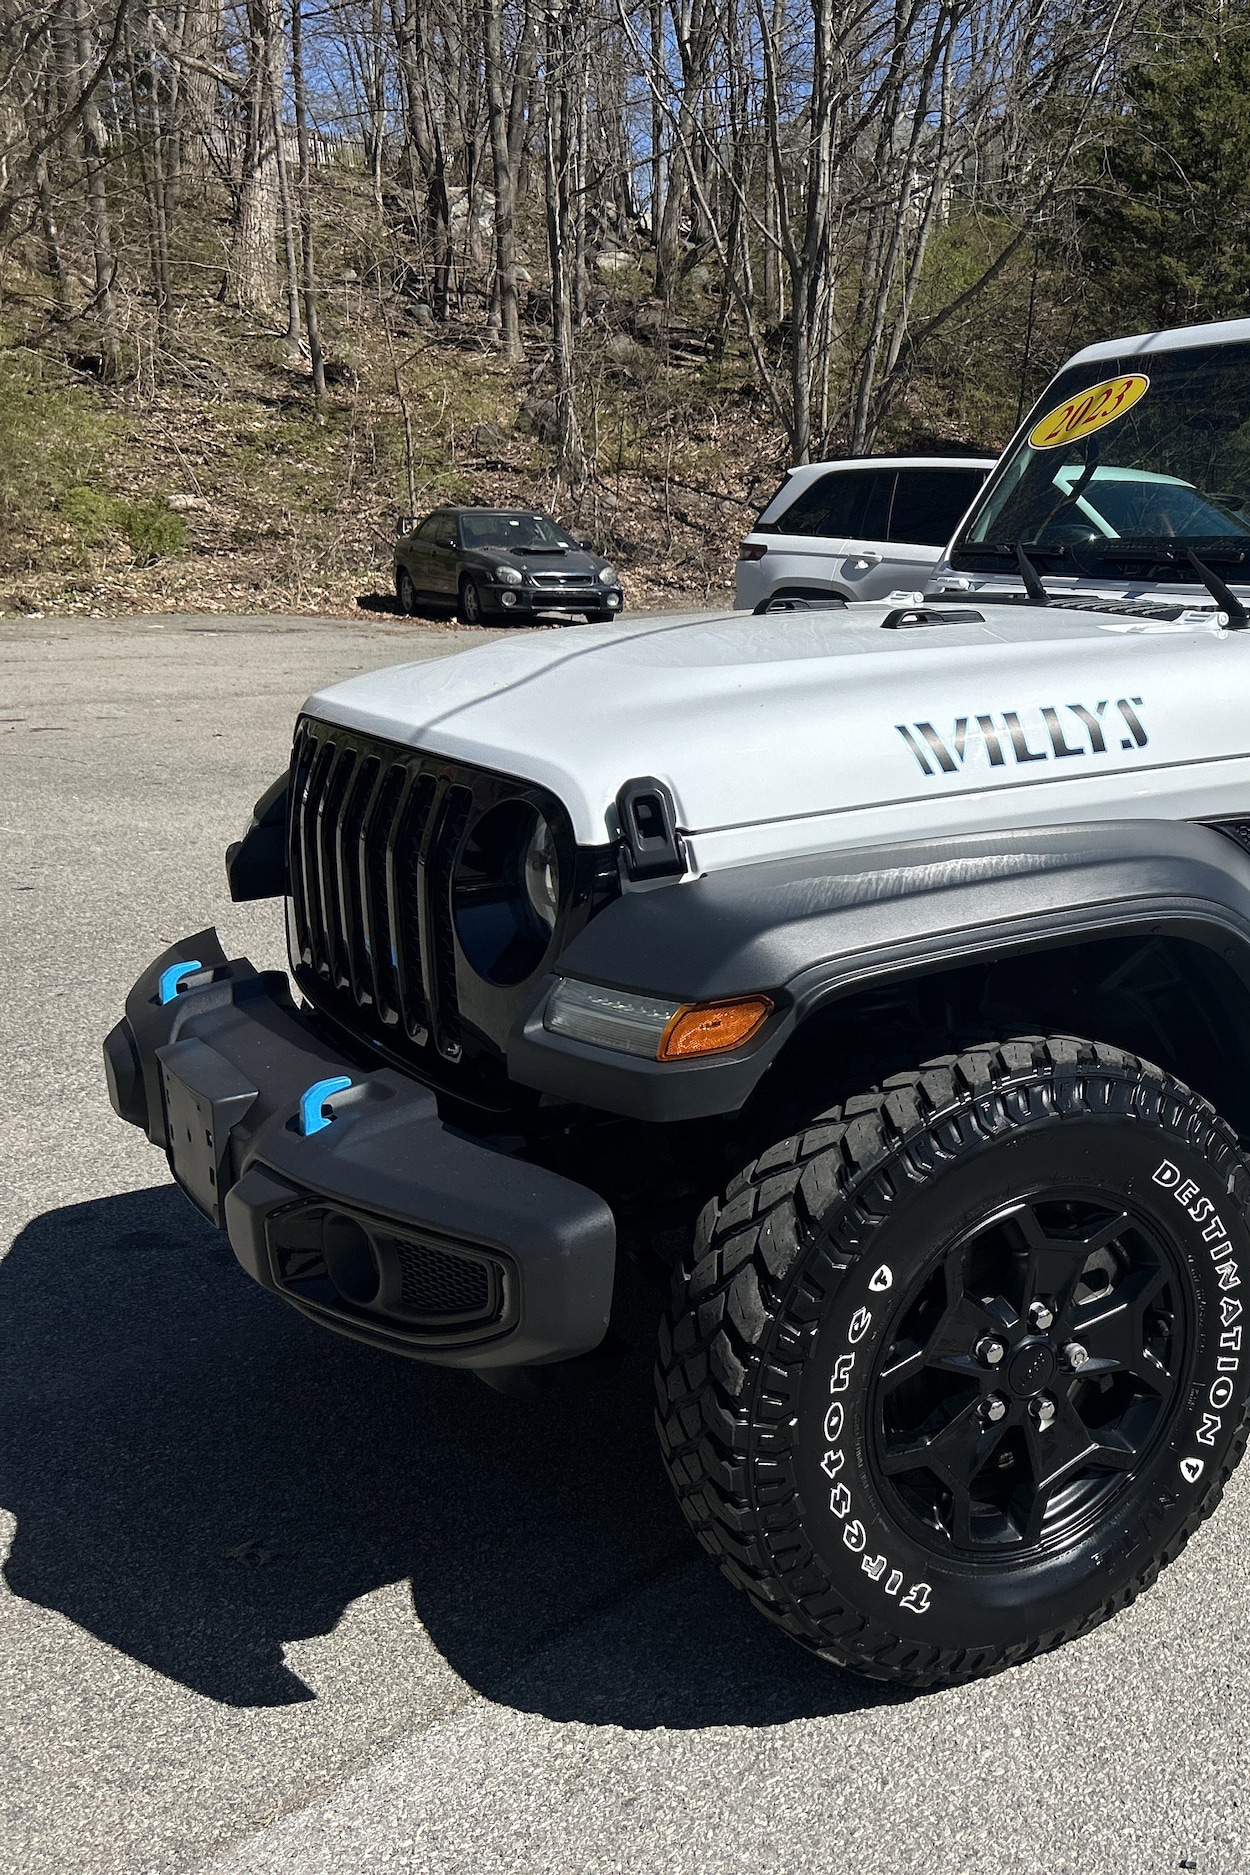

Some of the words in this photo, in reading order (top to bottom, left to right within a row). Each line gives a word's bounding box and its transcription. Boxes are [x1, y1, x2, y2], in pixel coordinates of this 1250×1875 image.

[1044, 380, 1133, 441] 2023
[894, 697, 1149, 776] WILLYS
[1153, 1159, 1243, 1444] DESTINATION
[823, 1307, 932, 1613] Firestone
